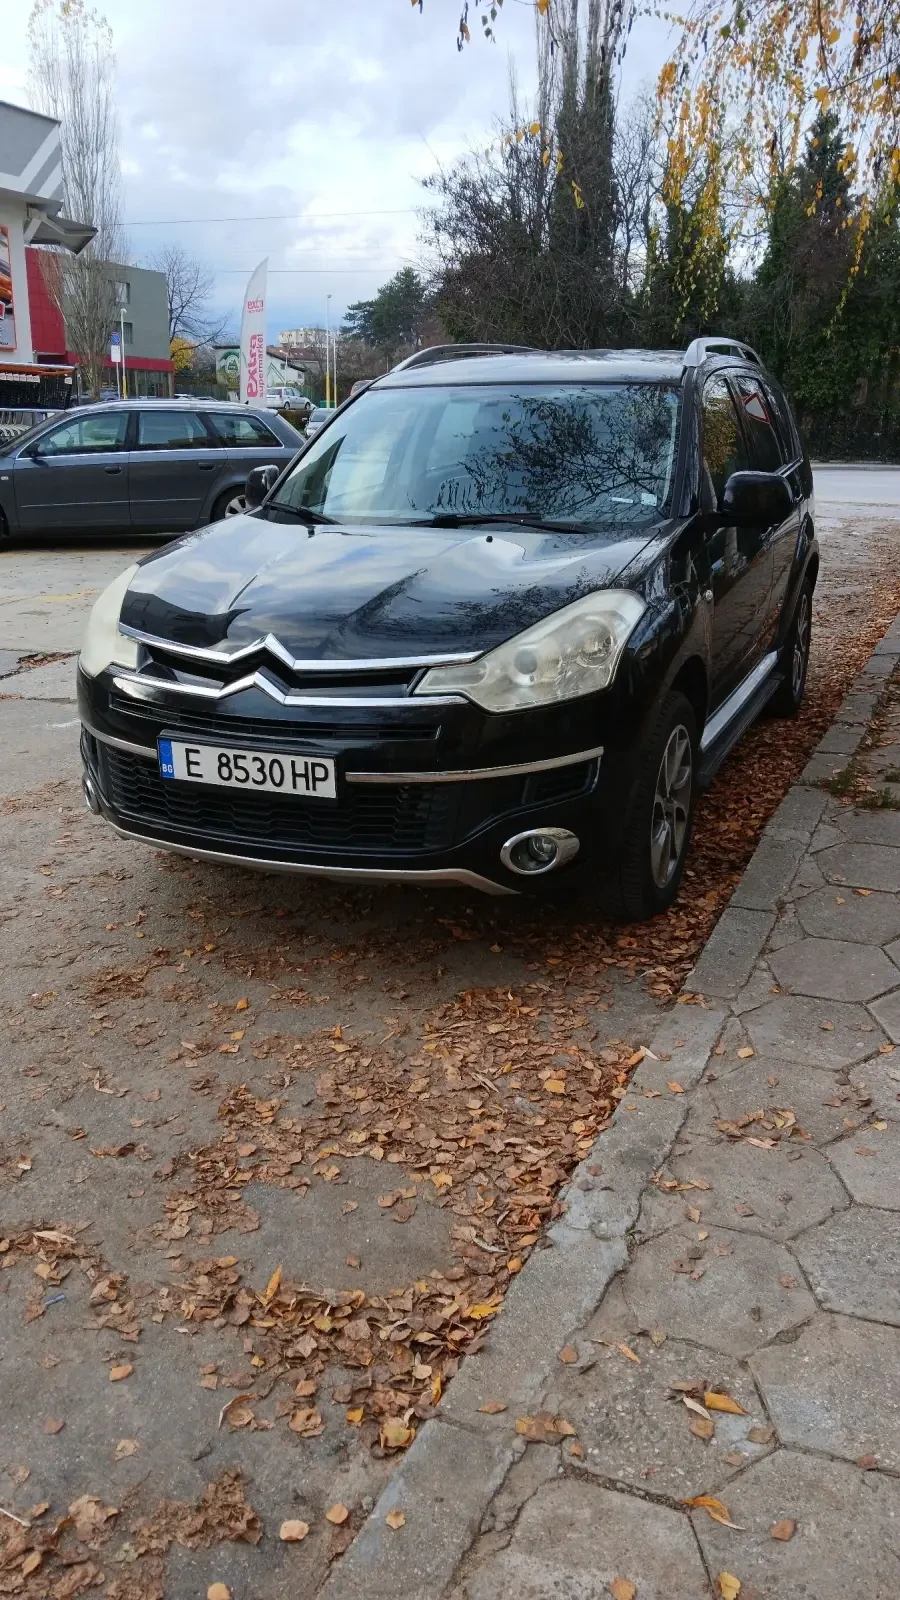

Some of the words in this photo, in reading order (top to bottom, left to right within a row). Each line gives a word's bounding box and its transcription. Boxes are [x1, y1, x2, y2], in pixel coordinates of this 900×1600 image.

[246, 334, 258, 398] extra
[256, 333, 265, 398] supermarket
[162, 763, 174, 774] BG
[185, 748, 203, 779] E
[217, 752, 285, 788] 8530
[290, 759, 329, 792] HP
